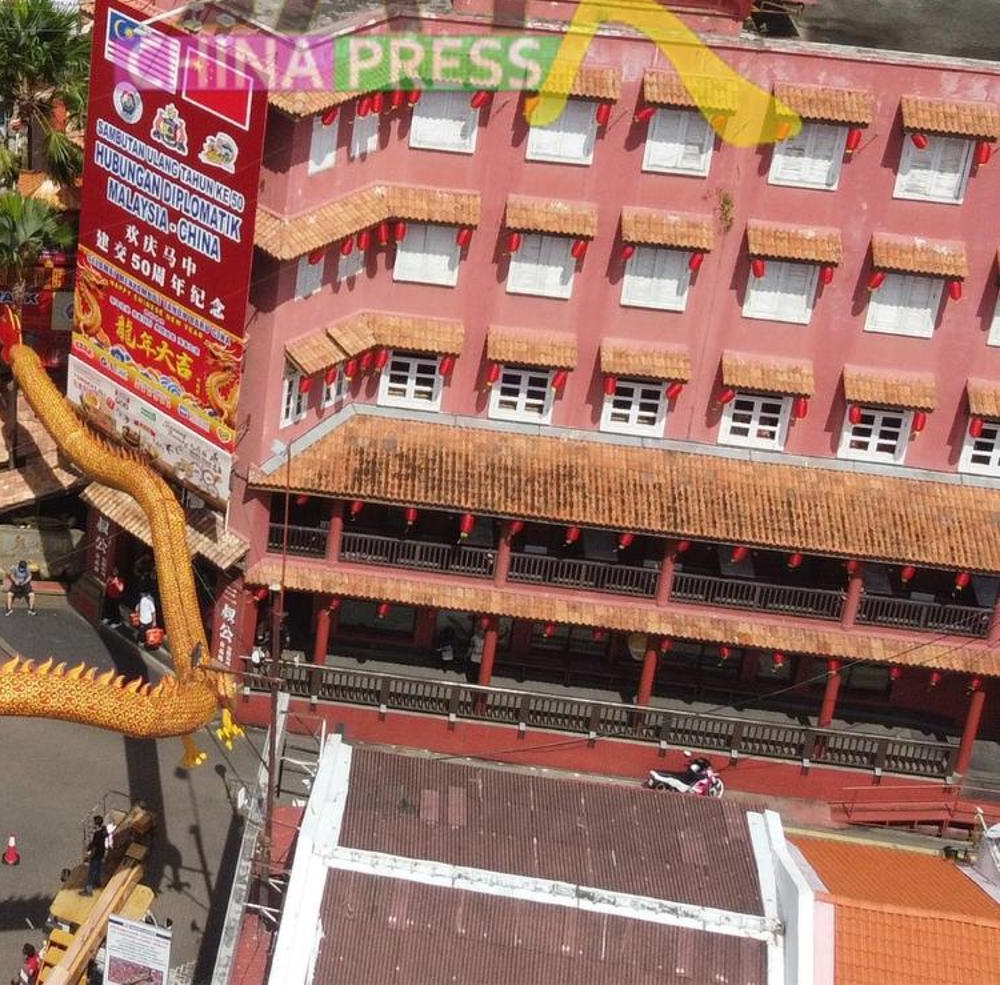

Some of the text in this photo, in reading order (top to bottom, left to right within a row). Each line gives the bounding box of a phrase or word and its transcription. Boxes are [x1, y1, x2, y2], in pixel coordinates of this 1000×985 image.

[95, 142, 242, 243] HUBUNGAN DIPLOMATIK
[96, 119, 244, 212] SAMBUTAN ULANG TAHUN KE 50
[107, 177, 168, 233] MALAYSIA
[177, 218, 221, 262] CHINA
[124, 224, 197, 277] 欢庆马中
[95, 229, 227, 320] 建交50周年纪念
[115, 313, 194, 379] 龍年大吉
